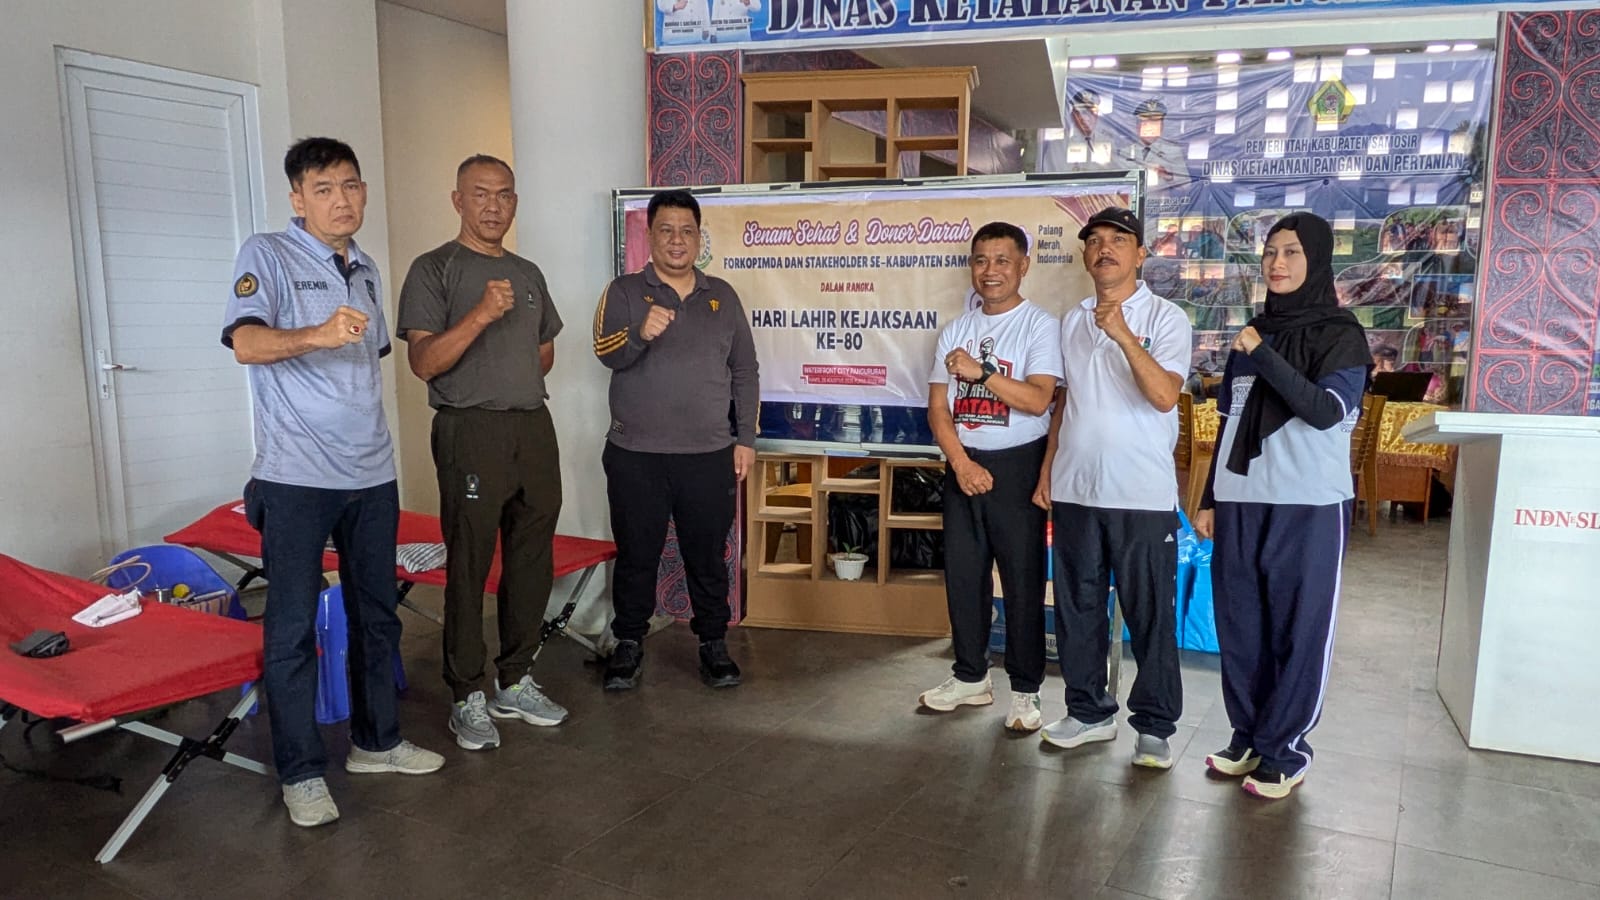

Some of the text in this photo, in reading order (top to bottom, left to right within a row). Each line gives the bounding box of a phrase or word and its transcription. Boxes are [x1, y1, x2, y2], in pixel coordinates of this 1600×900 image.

[1245, 134, 1418, 153] PEMERINTAH KABUPATEN SAMOSIR
[1203, 152, 1465, 176] DINAS KETAHANAN PANGAN DAN PERTANIAN
[743, 217, 973, 247] Senam Sehat & Donor Darah
[1038, 224, 1063, 238] Palang
[1037, 239, 1060, 250] Merah
[723, 256, 783, 269] FORKOPIMDA
[784, 256, 803, 269] DAN
[804, 256, 868, 269] STAKEHOLDER
[869, 255, 942, 268] SE-KABUPATEN
[1037, 252, 1073, 264] Indonesia
[820, 281, 874, 292] DALAM RANGKA
[752, 309, 937, 329] HARI LAHIR KEJAKSAAN
[816, 332, 863, 350] KE-80
